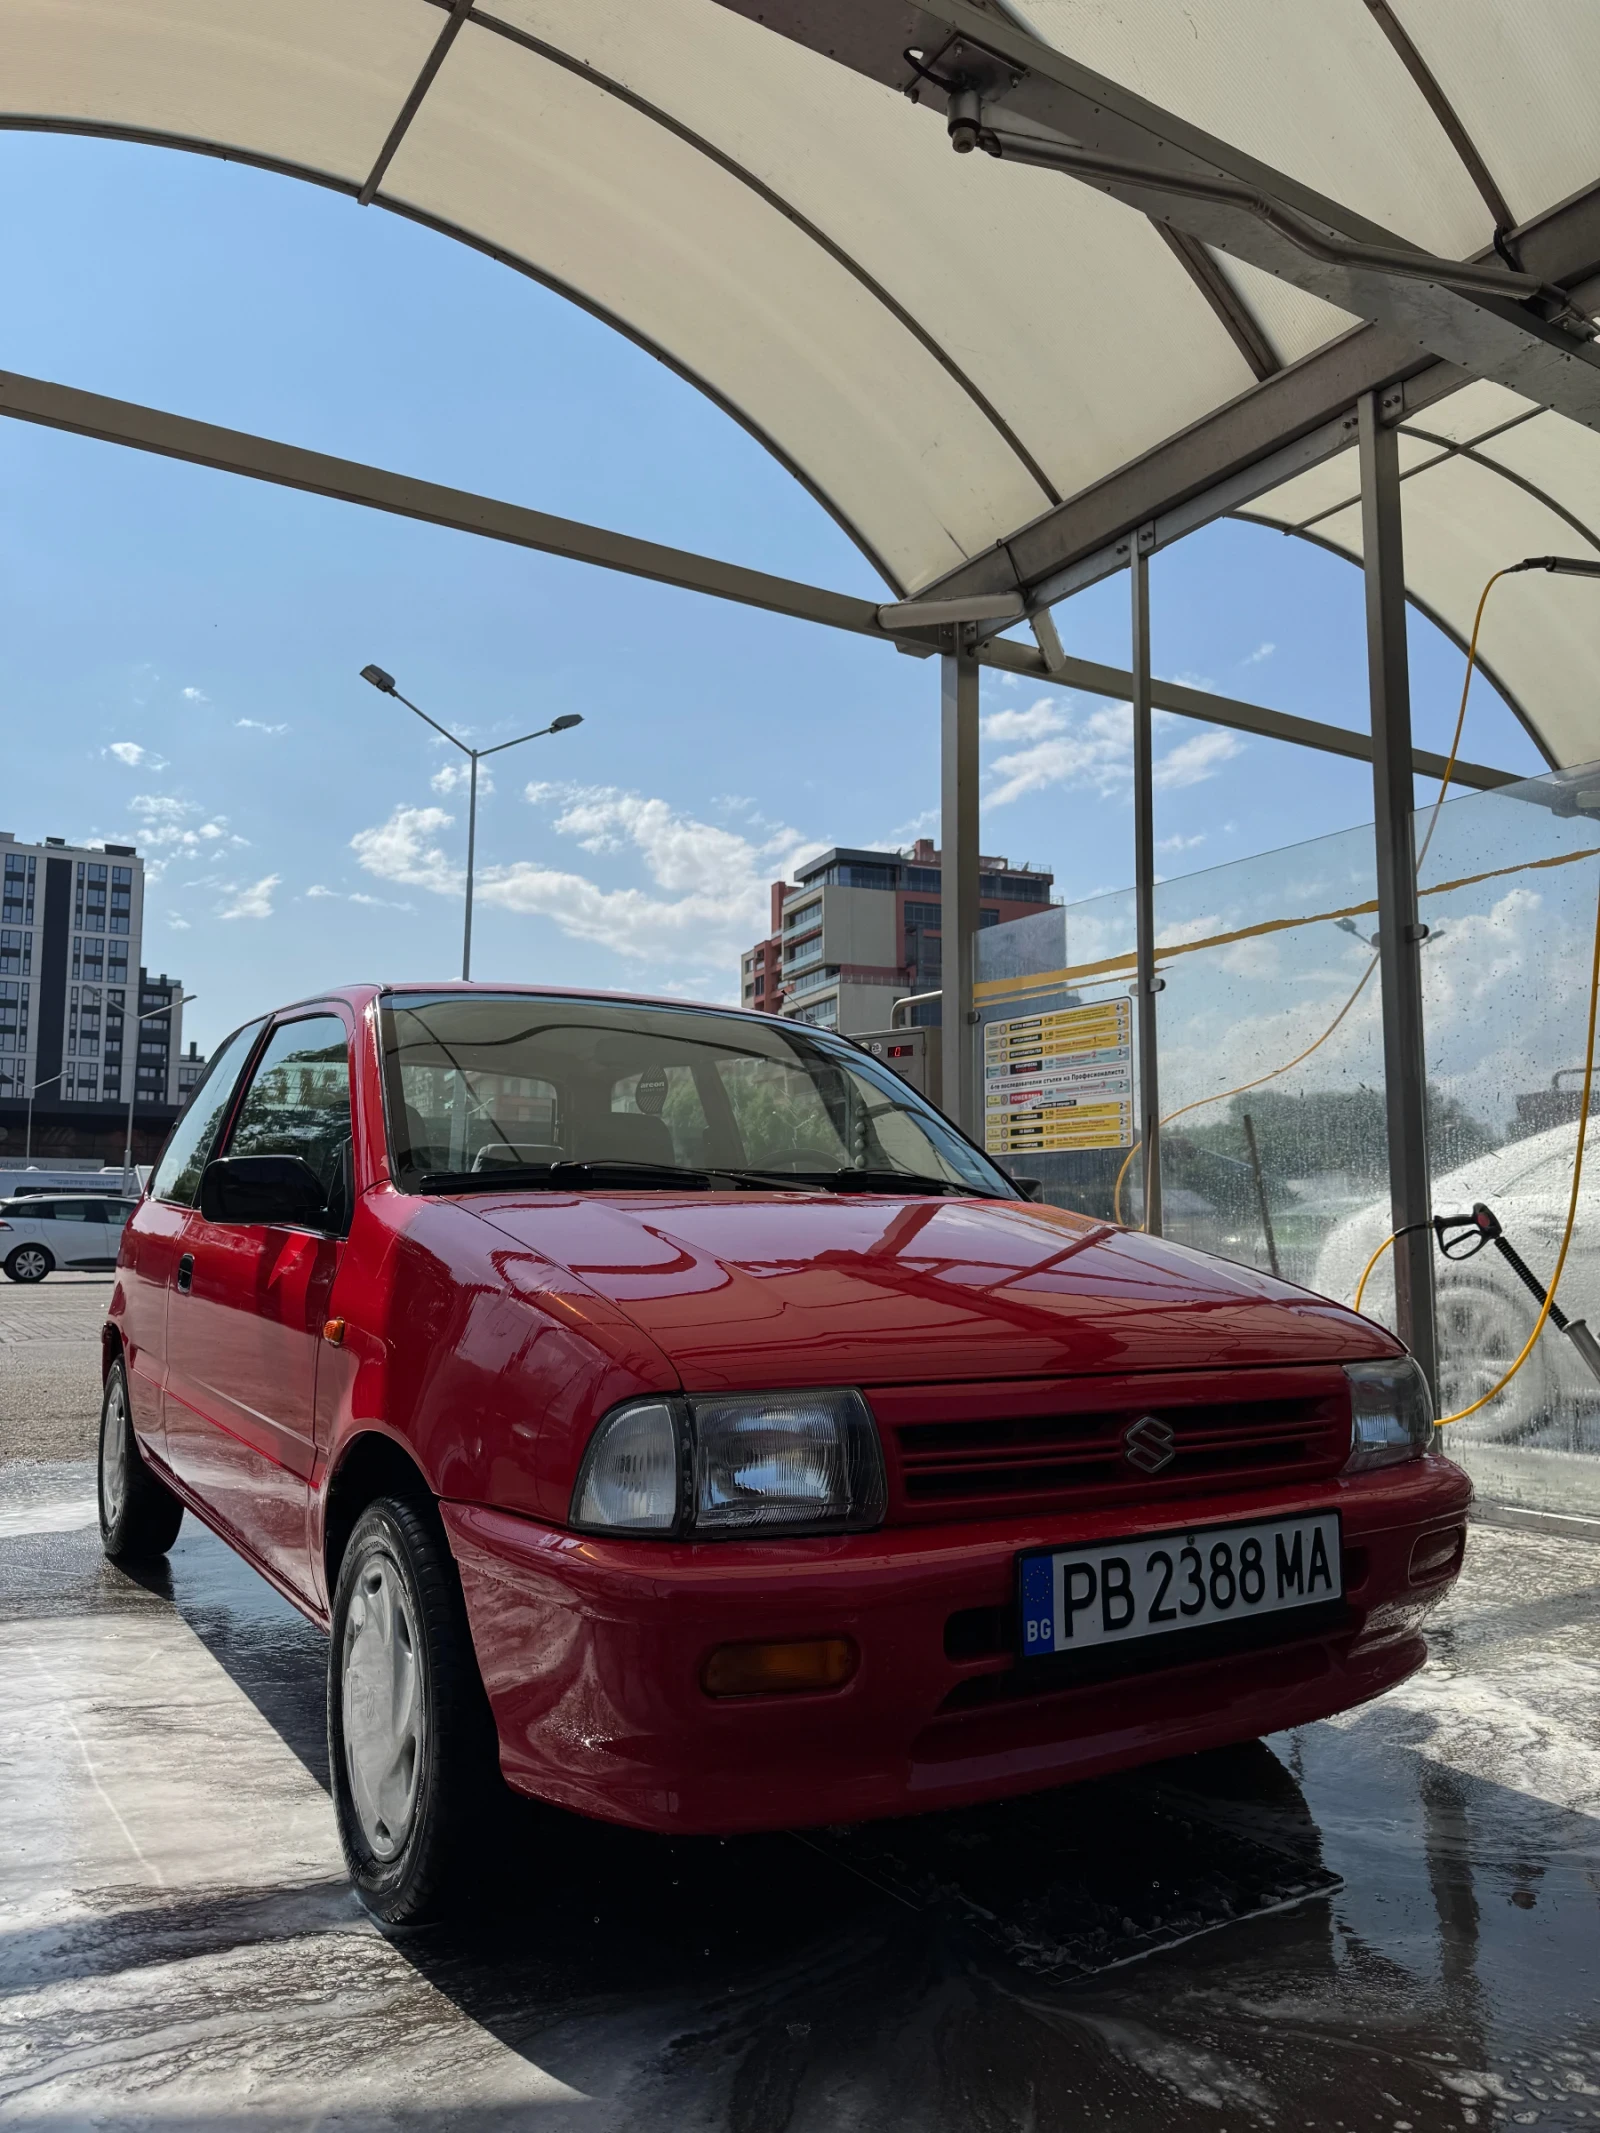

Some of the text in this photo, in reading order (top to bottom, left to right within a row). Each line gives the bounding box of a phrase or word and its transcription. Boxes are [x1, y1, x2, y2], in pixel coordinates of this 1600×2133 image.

[1071, 1069, 1125, 1081] Професионалиста
[1063, 1526, 1333, 1639] PB 2388 MA
[1026, 1617, 1051, 1642] BG
